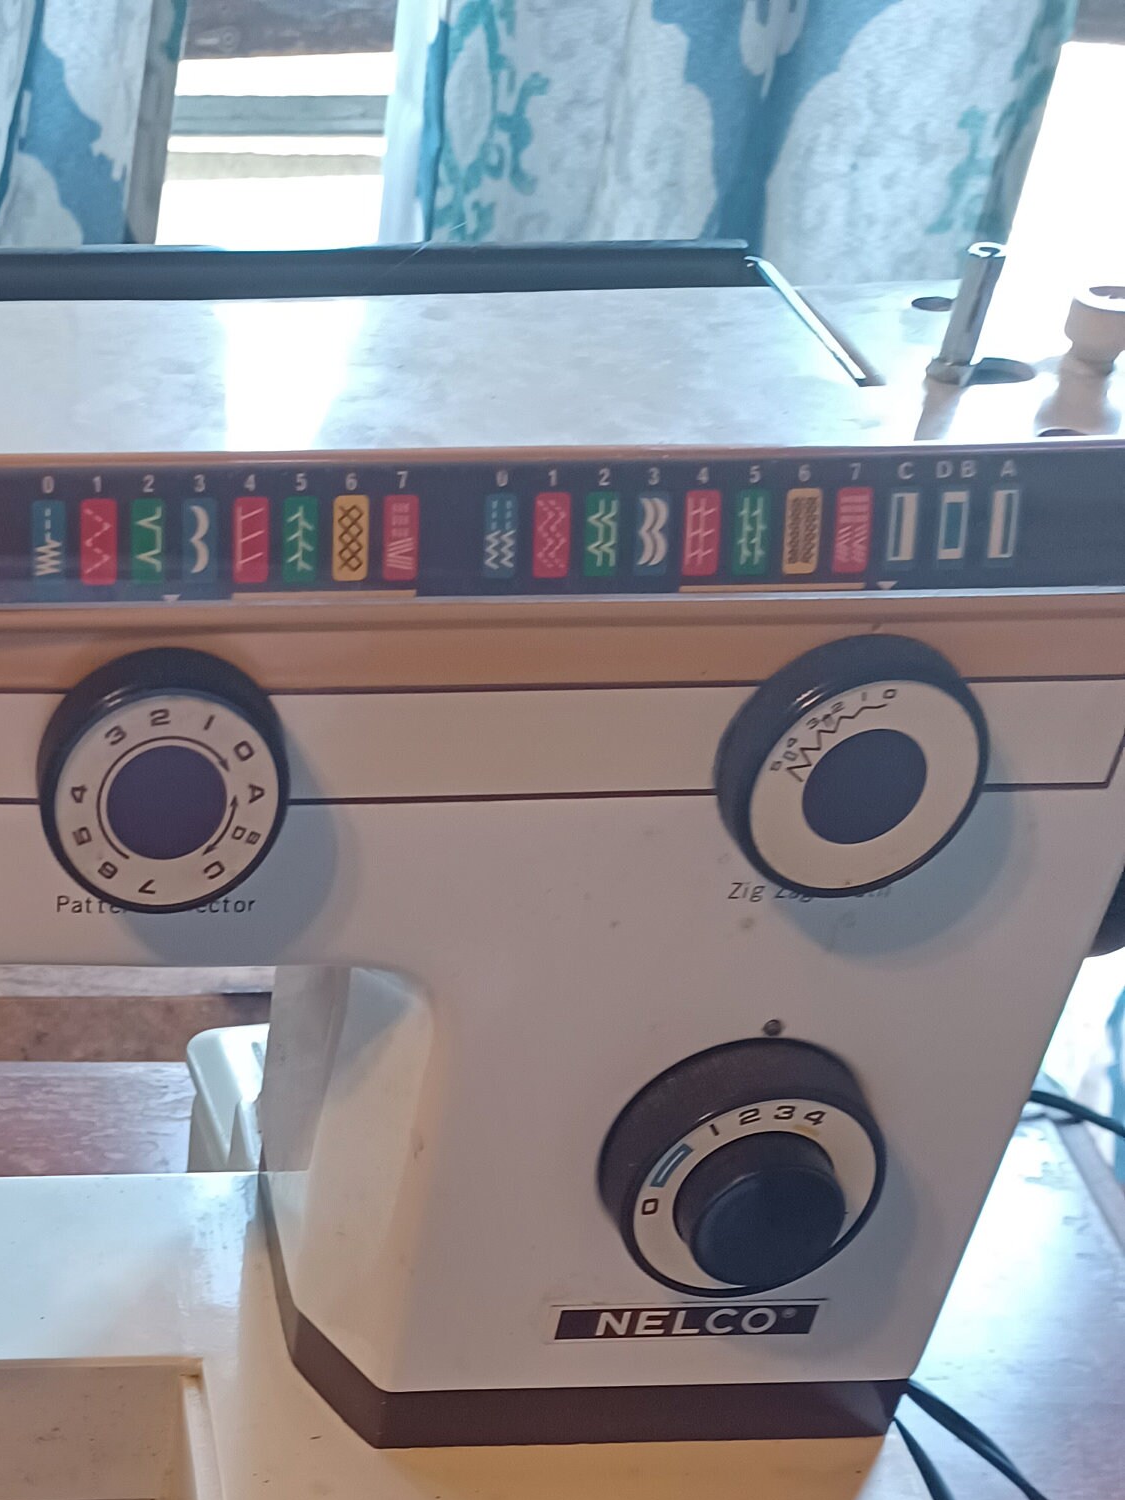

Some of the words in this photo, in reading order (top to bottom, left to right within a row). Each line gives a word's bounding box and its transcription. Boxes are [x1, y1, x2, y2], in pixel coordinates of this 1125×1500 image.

[42, 474, 55, 494] 0
[93, 475, 102, 493] 1
[142, 473, 156, 493] 2
[193, 473, 206, 493] 3
[244, 472, 257, 492] 4
[295, 471, 308, 491] 5
[345, 471, 358, 491] 6
[396, 470, 409, 489] 7
[548, 468, 557, 486] 1
[598, 467, 611, 486] 2
[647, 467, 660, 486] 3
[696, 466, 709, 485] 4
[748, 465, 761, 485] 5
[797, 464, 811, 483] 6
[849, 462, 862, 481] 7
[897, 461, 915, 480] C
[1000, 459, 1017, 478] A
[149, 708, 172, 727] 2
[203, 714, 216, 731] 1
[104, 725, 127, 746] 3
[247, 783, 266, 804] A
[137, 879, 157, 894] 7
[728, 881, 765, 903] Zig
[708, 1123, 721, 1137] 1
[738, 1107, 763, 1126] 2
[773, 1105, 796, 1121] 3
[802, 1109, 827, 1126] 4
[595, 1307, 777, 1337] NELCO
